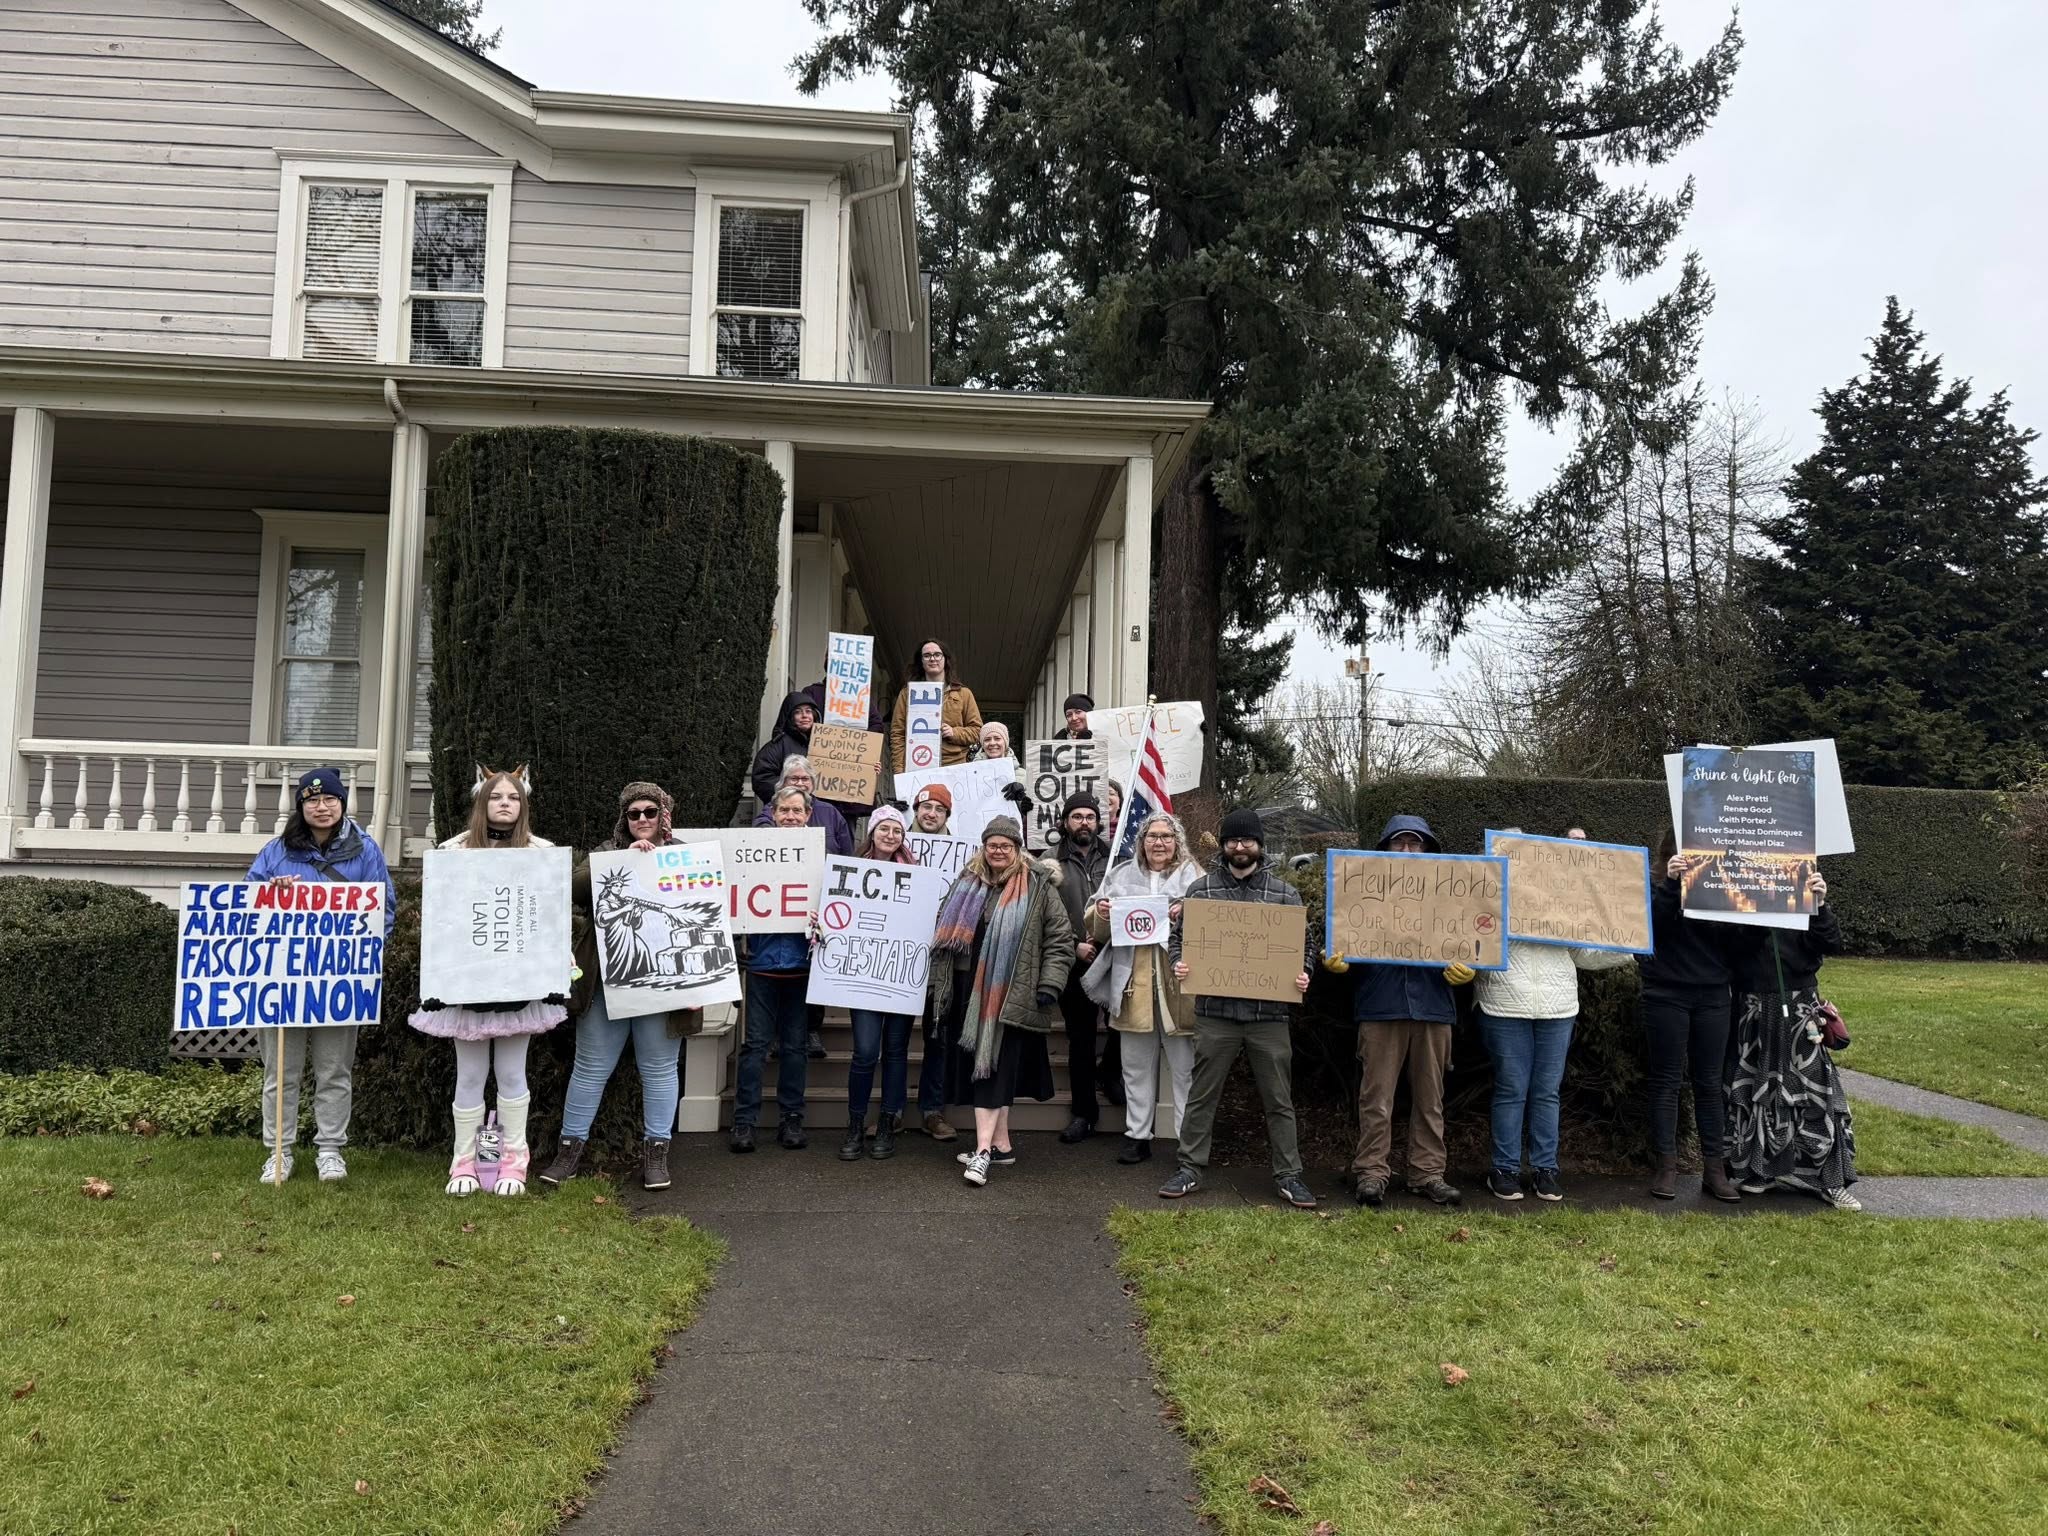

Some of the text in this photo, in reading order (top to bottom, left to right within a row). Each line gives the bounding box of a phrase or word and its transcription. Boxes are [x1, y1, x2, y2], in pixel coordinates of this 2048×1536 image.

[834, 638, 866, 657] ICE
[829, 659, 870, 683] MELTS
[840, 681, 860, 696] IN
[828, 697, 866, 720] HELL
[1115, 708, 1181, 738] PECE
[814, 737, 868, 753] FUNDING
[840, 729, 868, 741] STOP
[1040, 744, 1095, 773] ICE
[910, 768, 1008, 802] Aolish
[1693, 767, 1800, 785] Shine a light for
[1034, 774, 1101, 802] OUT
[1726, 794, 1769, 803] Alex Pretti
[1741, 816, 1767, 824] Porter
[1750, 806, 1772, 814] Good
[1694, 826, 1722, 834] Herber
[1712, 837, 1737, 845] Victor
[1738, 838, 1767, 846] Manuel
[735, 848, 805, 863] SECRET
[1568, 849, 1616, 872] NAMES
[658, 871, 723, 892] GTFO!
[1736, 883, 1760, 891] Lunas
[1761, 884, 1795, 892] Campos
[187, 884, 381, 911] ICE MURDERS.
[184, 911, 373, 936] MARIE APPROVES.
[472, 902, 488, 946] LAND
[493, 887, 511, 952] STOLEN
[516, 885, 525, 953] IMMIGRANTS ON
[530, 919, 538, 932] ALL
[1129, 917, 1152, 932] ICE
[1208, 904, 1283, 927] SERVE NO
[1393, 905, 1423, 933] Red
[1433, 908, 1467, 935] hat
[1510, 917, 1635, 944] DEFUND ICE NOW
[181, 936, 383, 979] FASCIST ENABLER
[818, 933, 931, 988] GESTAPO
[1207, 968, 1281, 991] SOVEREIGN
[180, 978, 381, 1029] RESIGN NOW
